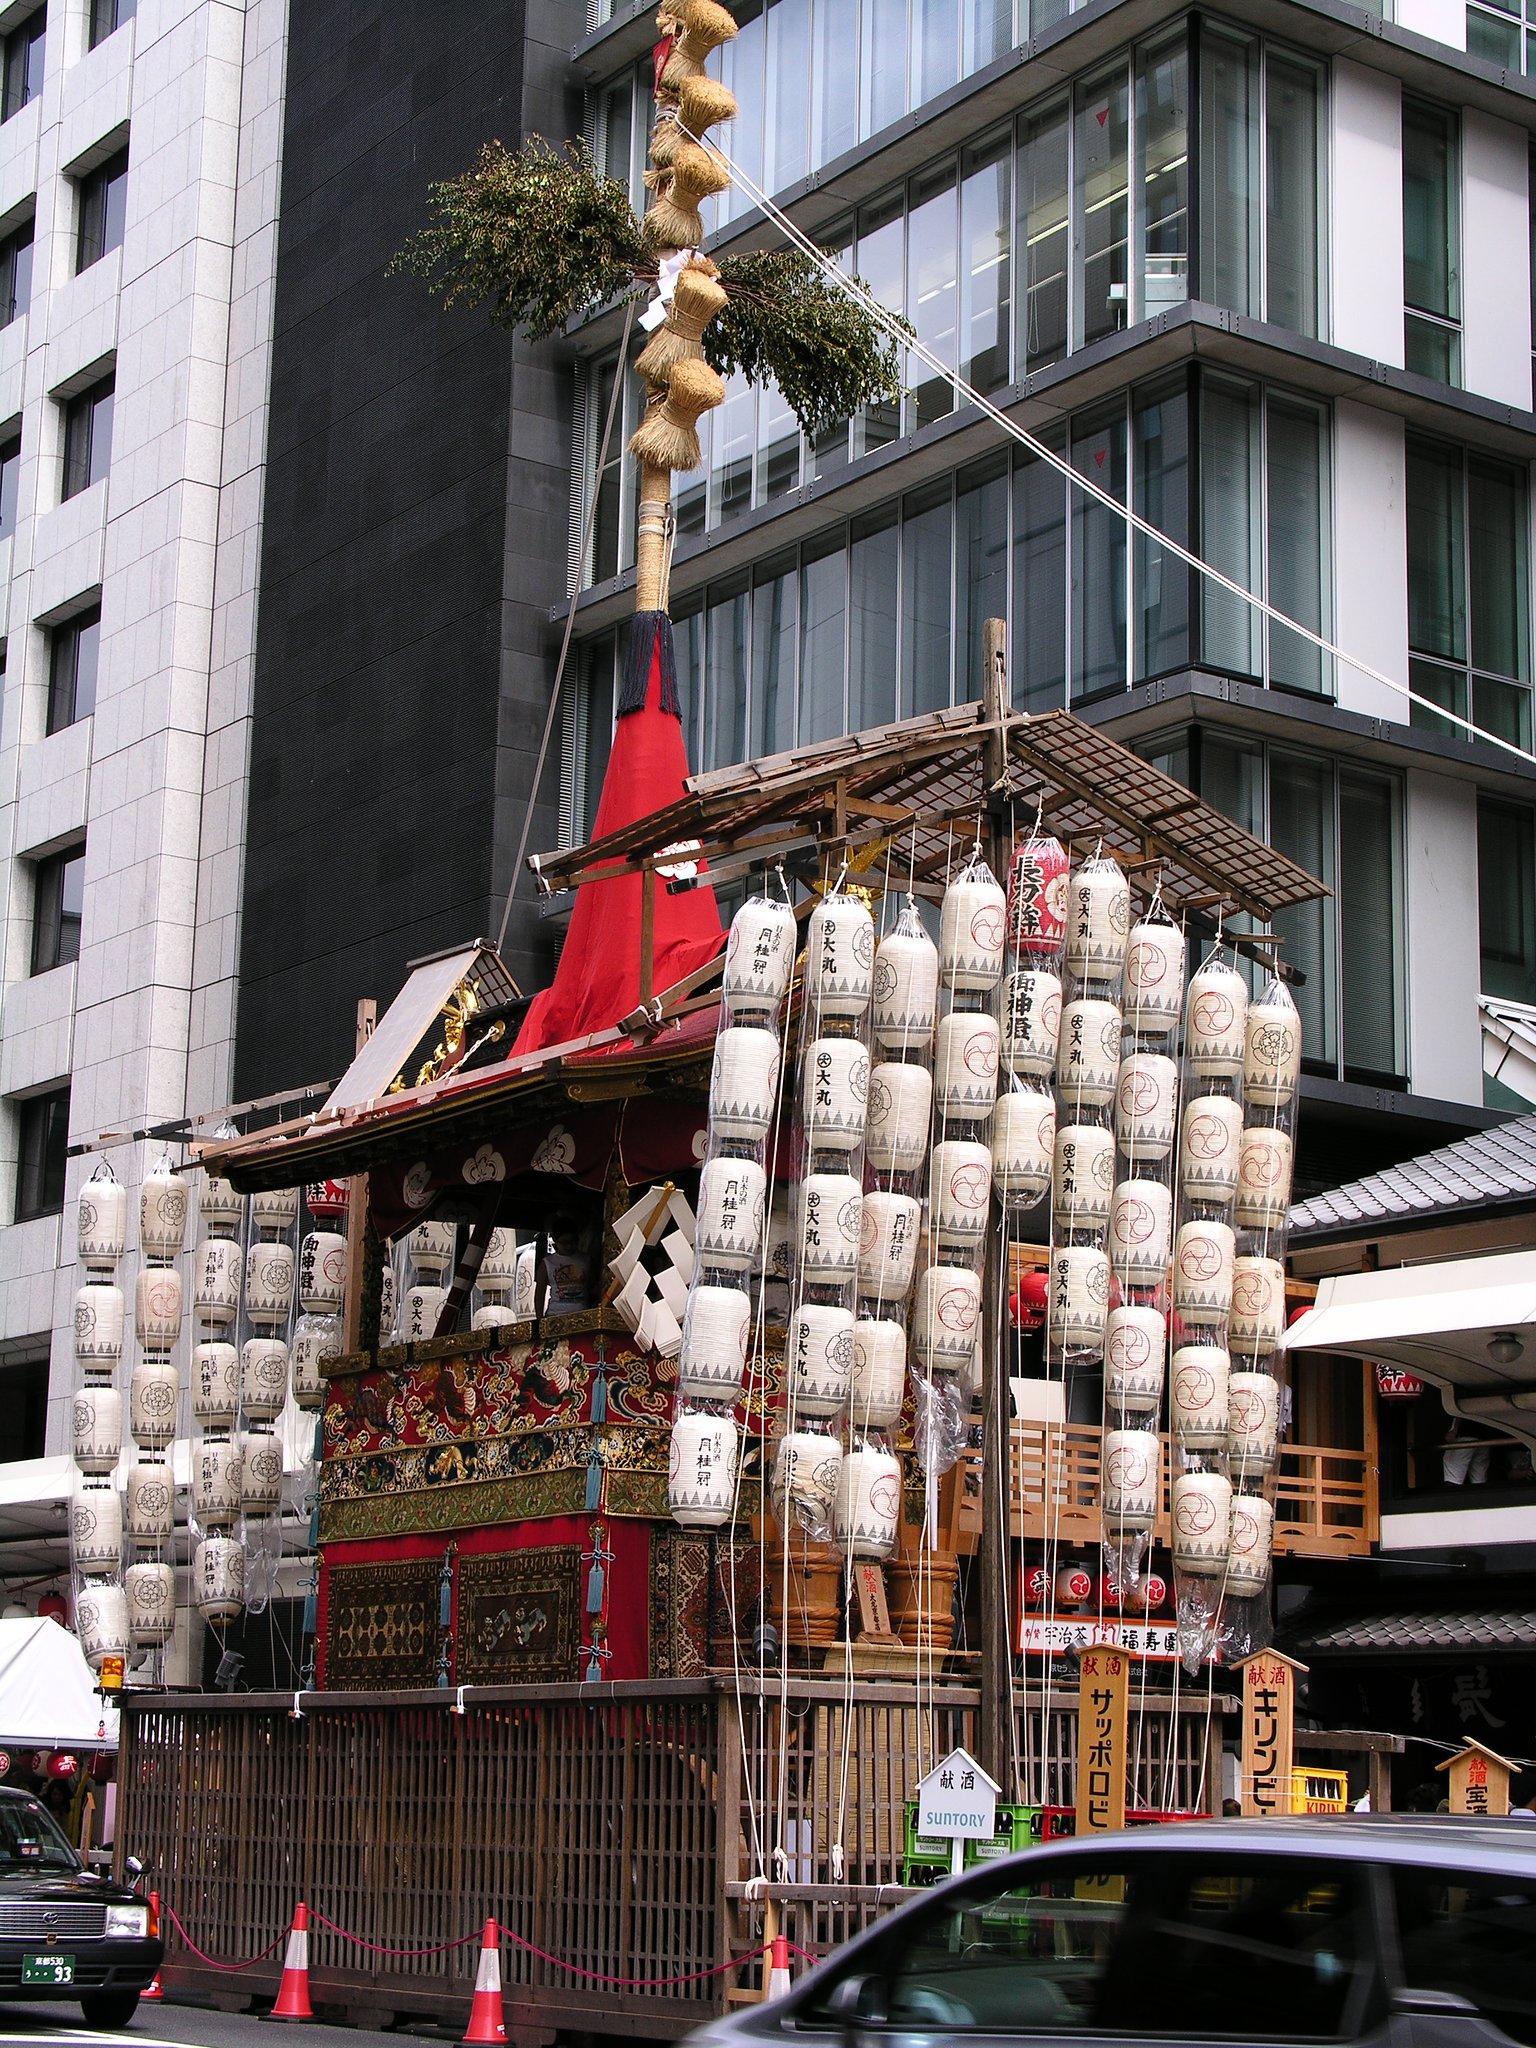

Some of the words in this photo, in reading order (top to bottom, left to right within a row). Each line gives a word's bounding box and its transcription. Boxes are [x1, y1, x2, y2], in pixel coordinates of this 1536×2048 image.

[1011, 854, 1045, 936] 長刀鉾
[1078, 903, 1092, 939] 大丸
[753, 927, 773, 975] 月桂冠
[822, 936, 837, 974] 大丸
[1069, 1030, 1085, 1066] 大丸
[816, 1069, 832, 1106] 大丸
[1062, 1159, 1077, 1194] 大丸
[720, 1180, 739, 1230] 月桂冠
[806, 1209, 821, 1246] 大丸
[889, 1213, 907, 1261] 月桂冠
[382, 1291, 393, 1318] 大丸
[1056, 1275, 1071, 1309] 大丸
[411, 1308, 423, 1336] 大丸
[696, 1437, 713, 1487] 月桂冠
[1044, 1623, 1088, 1645] 宇治茶
[1121, 1629, 1177, 1652] 福寿園
[1082, 1655, 1122, 1678] 献酒
[1247, 1665, 1286, 1686] 献酒
[1253, 1688, 1278, 1815] キリンビ
[940, 1769, 975, 1790] 献酒
[1469, 1758, 1487, 1783] 献酒
[926, 1811, 986, 1828] SUNTORY
[1307, 1801, 1339, 1815] KIRIN
